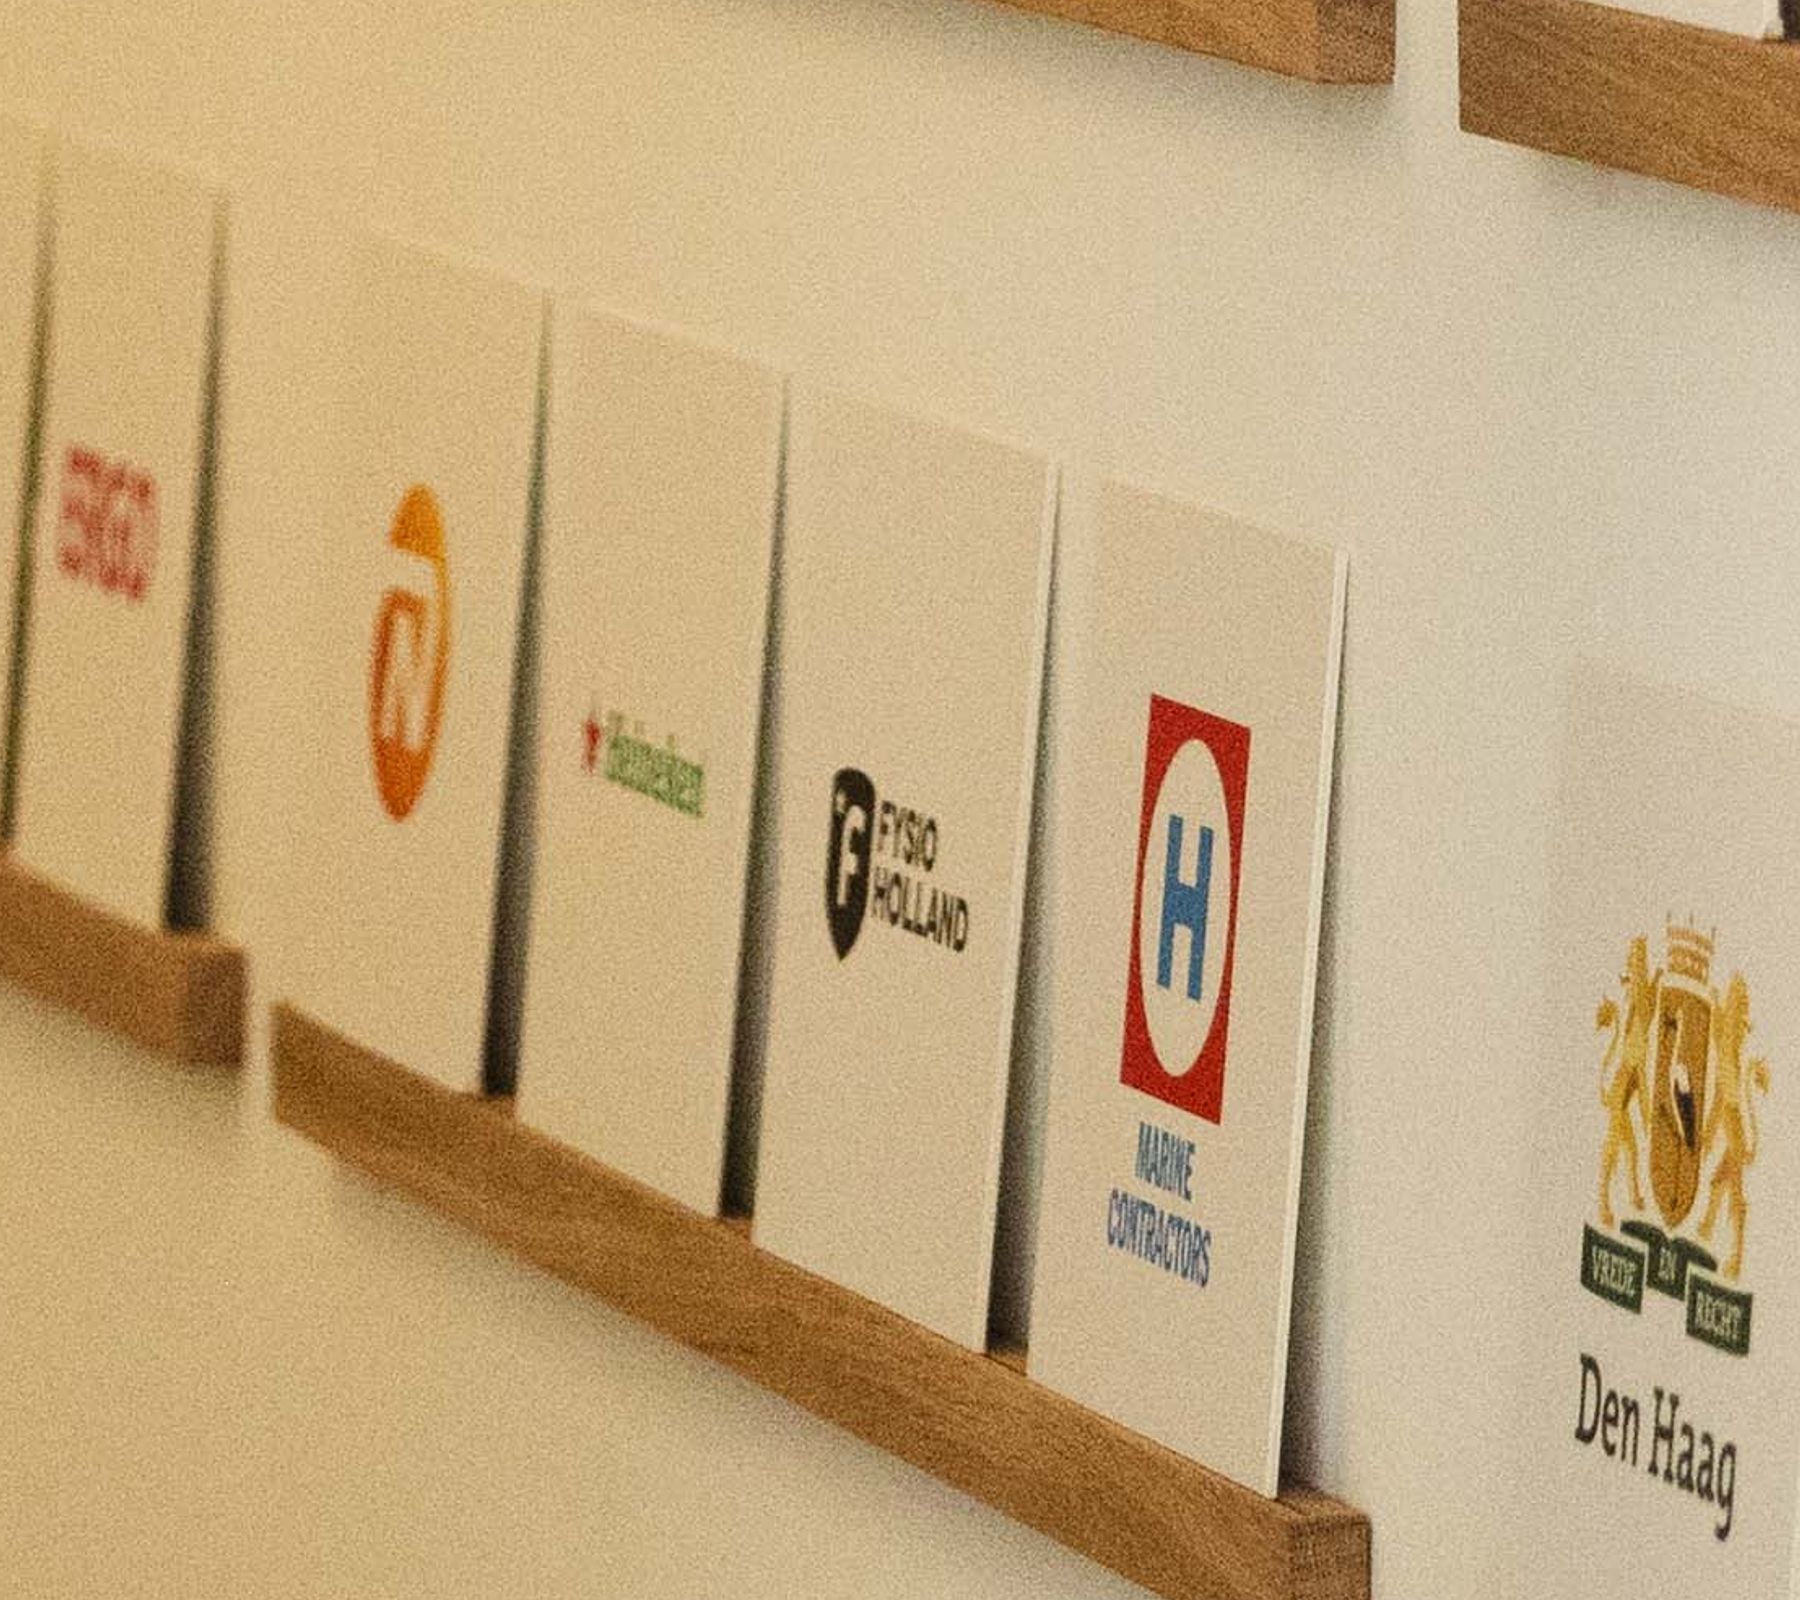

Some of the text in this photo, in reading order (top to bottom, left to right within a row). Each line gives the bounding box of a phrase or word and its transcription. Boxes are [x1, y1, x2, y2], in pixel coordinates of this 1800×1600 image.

[876, 800, 938, 873] FYSIO
[871, 865, 969, 953] HOLLAND
[1156, 813, 1214, 1002] H
[1135, 1121, 1196, 1204] MARINE
[1108, 1187, 1212, 1288] CONTRACTORS
[1591, 1245, 1637, 1298] VREDE
[1693, 1290, 1743, 1343] RECHT
[1575, 1353, 1738, 1543] Den Haag
